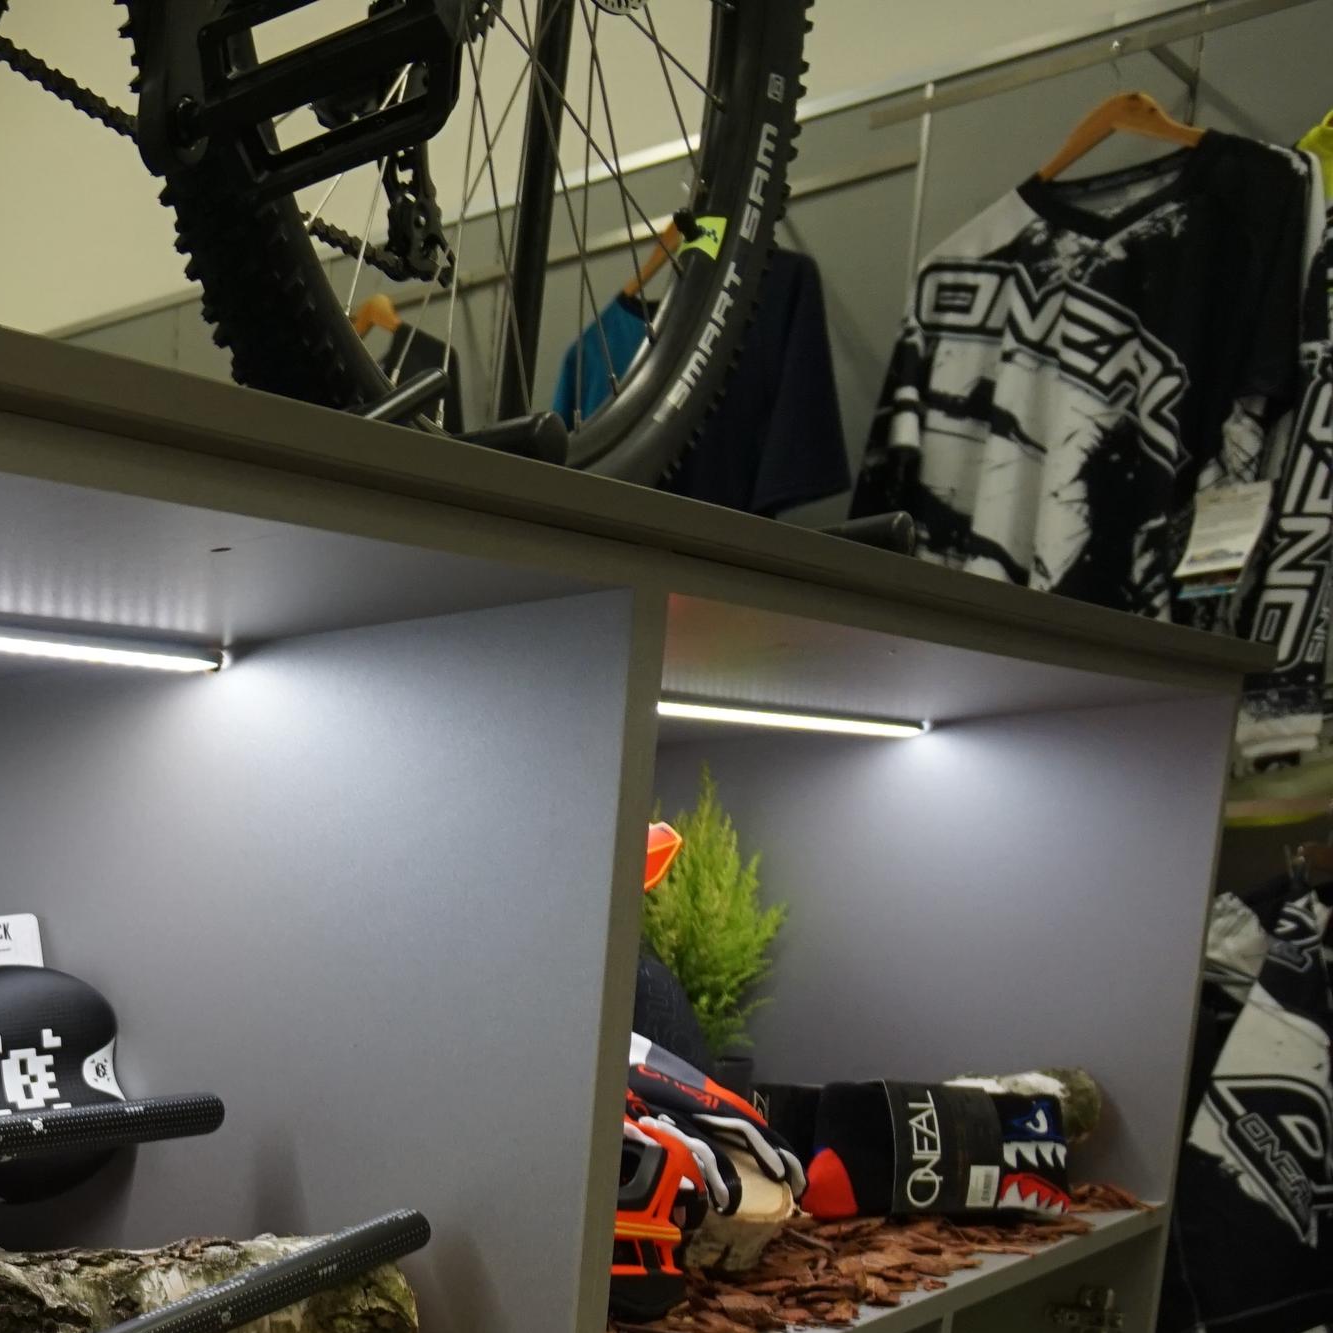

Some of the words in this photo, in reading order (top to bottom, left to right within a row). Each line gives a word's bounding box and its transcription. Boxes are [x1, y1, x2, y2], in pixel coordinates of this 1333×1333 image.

[666, 261, 742, 410] SMART
[739, 122, 779, 244] SAM
[917, 260, 1183, 464] ONEAL
